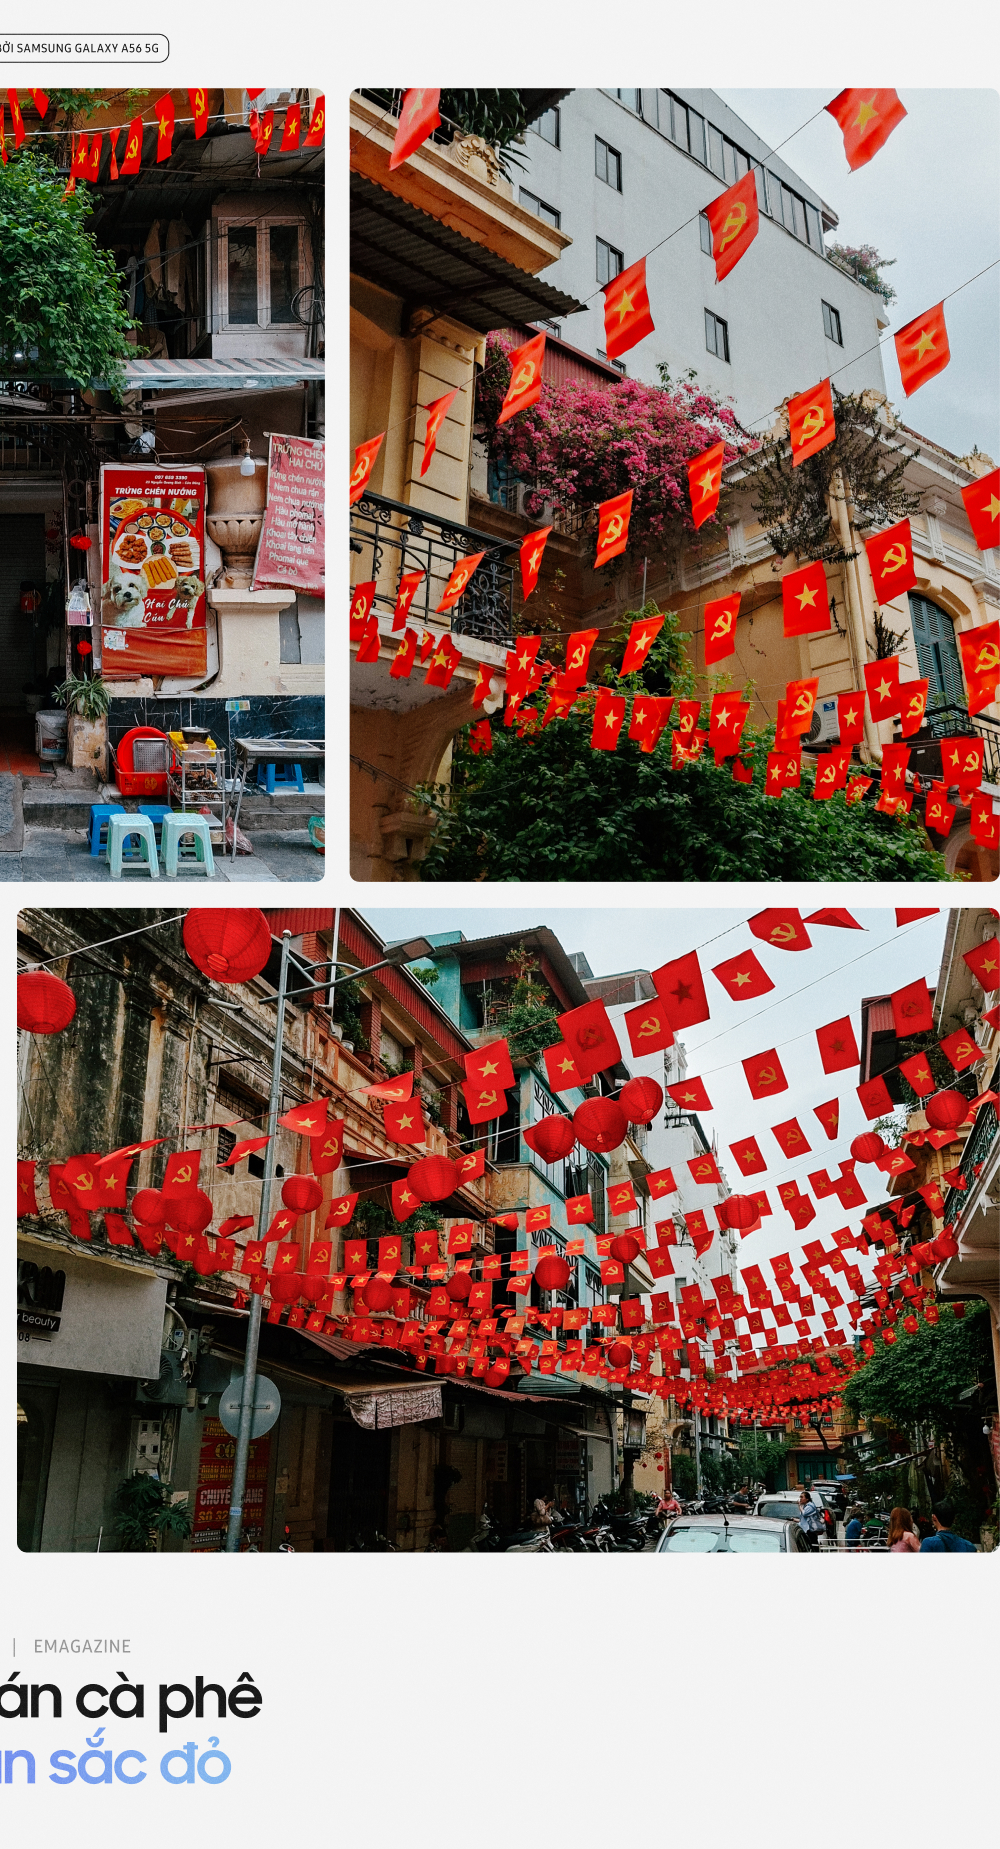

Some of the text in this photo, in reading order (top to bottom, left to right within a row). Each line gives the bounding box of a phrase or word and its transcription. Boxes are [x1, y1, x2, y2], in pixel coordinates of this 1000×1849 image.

[273, 443, 303, 457] TRỨNG
[289, 457, 323, 472] HAI CHÚ
[115, 486, 197, 496] TRỨNG CHÉN NƯỚNG
[274, 482, 289, 493] Nem
[291, 485, 307, 496] chua
[269, 493, 283, 503] Nem
[284, 496, 300, 506] chua
[266, 528, 286, 539] Khoai
[266, 540, 286, 550] Khoai
[288, 543, 302, 554] lang
[269, 552, 309, 566] Phomai que
[22, 1312, 57, 1330] beauty
